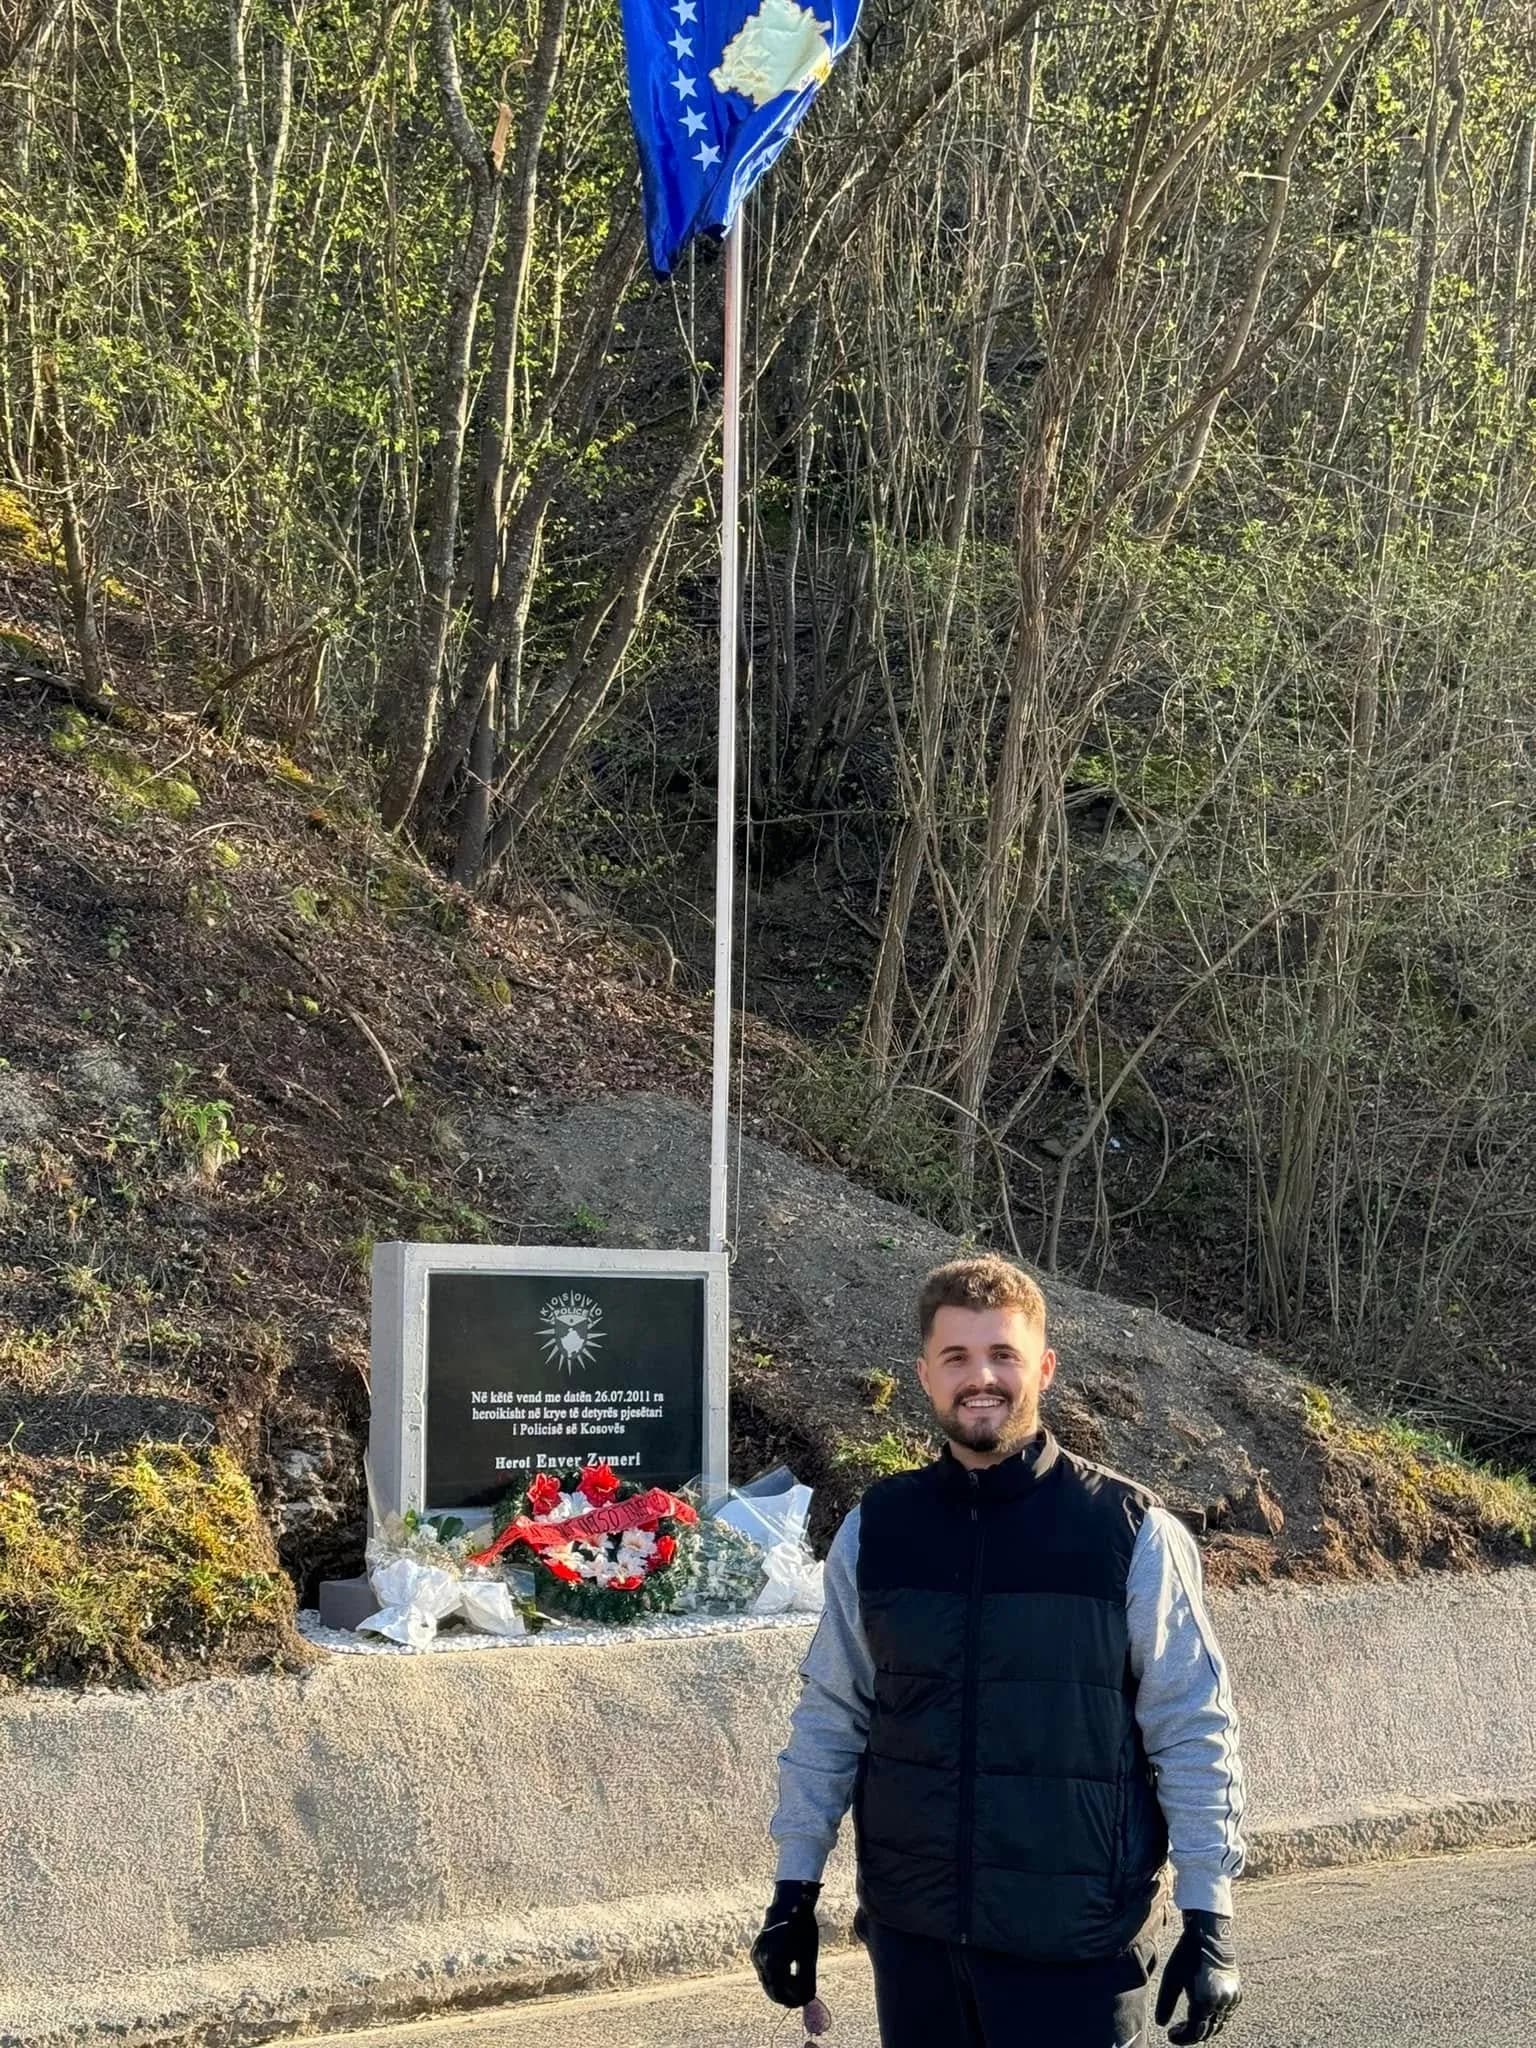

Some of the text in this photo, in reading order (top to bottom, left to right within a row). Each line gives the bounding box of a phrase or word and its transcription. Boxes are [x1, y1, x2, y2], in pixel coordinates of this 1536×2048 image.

[540, 1292, 602, 1317] KOSOVO
[553, 1307, 589, 1317] POLICE
[471, 1390, 664, 1404] Në këtë vend me datën 26.07.2011 ra
[472, 1405, 663, 1421] heroikisht në krye të detyrës pjesëtari
[512, 1421, 625, 1436] i Policisë së Kosovës
[495, 1451, 641, 1470] Heroi Enver Zymeri
